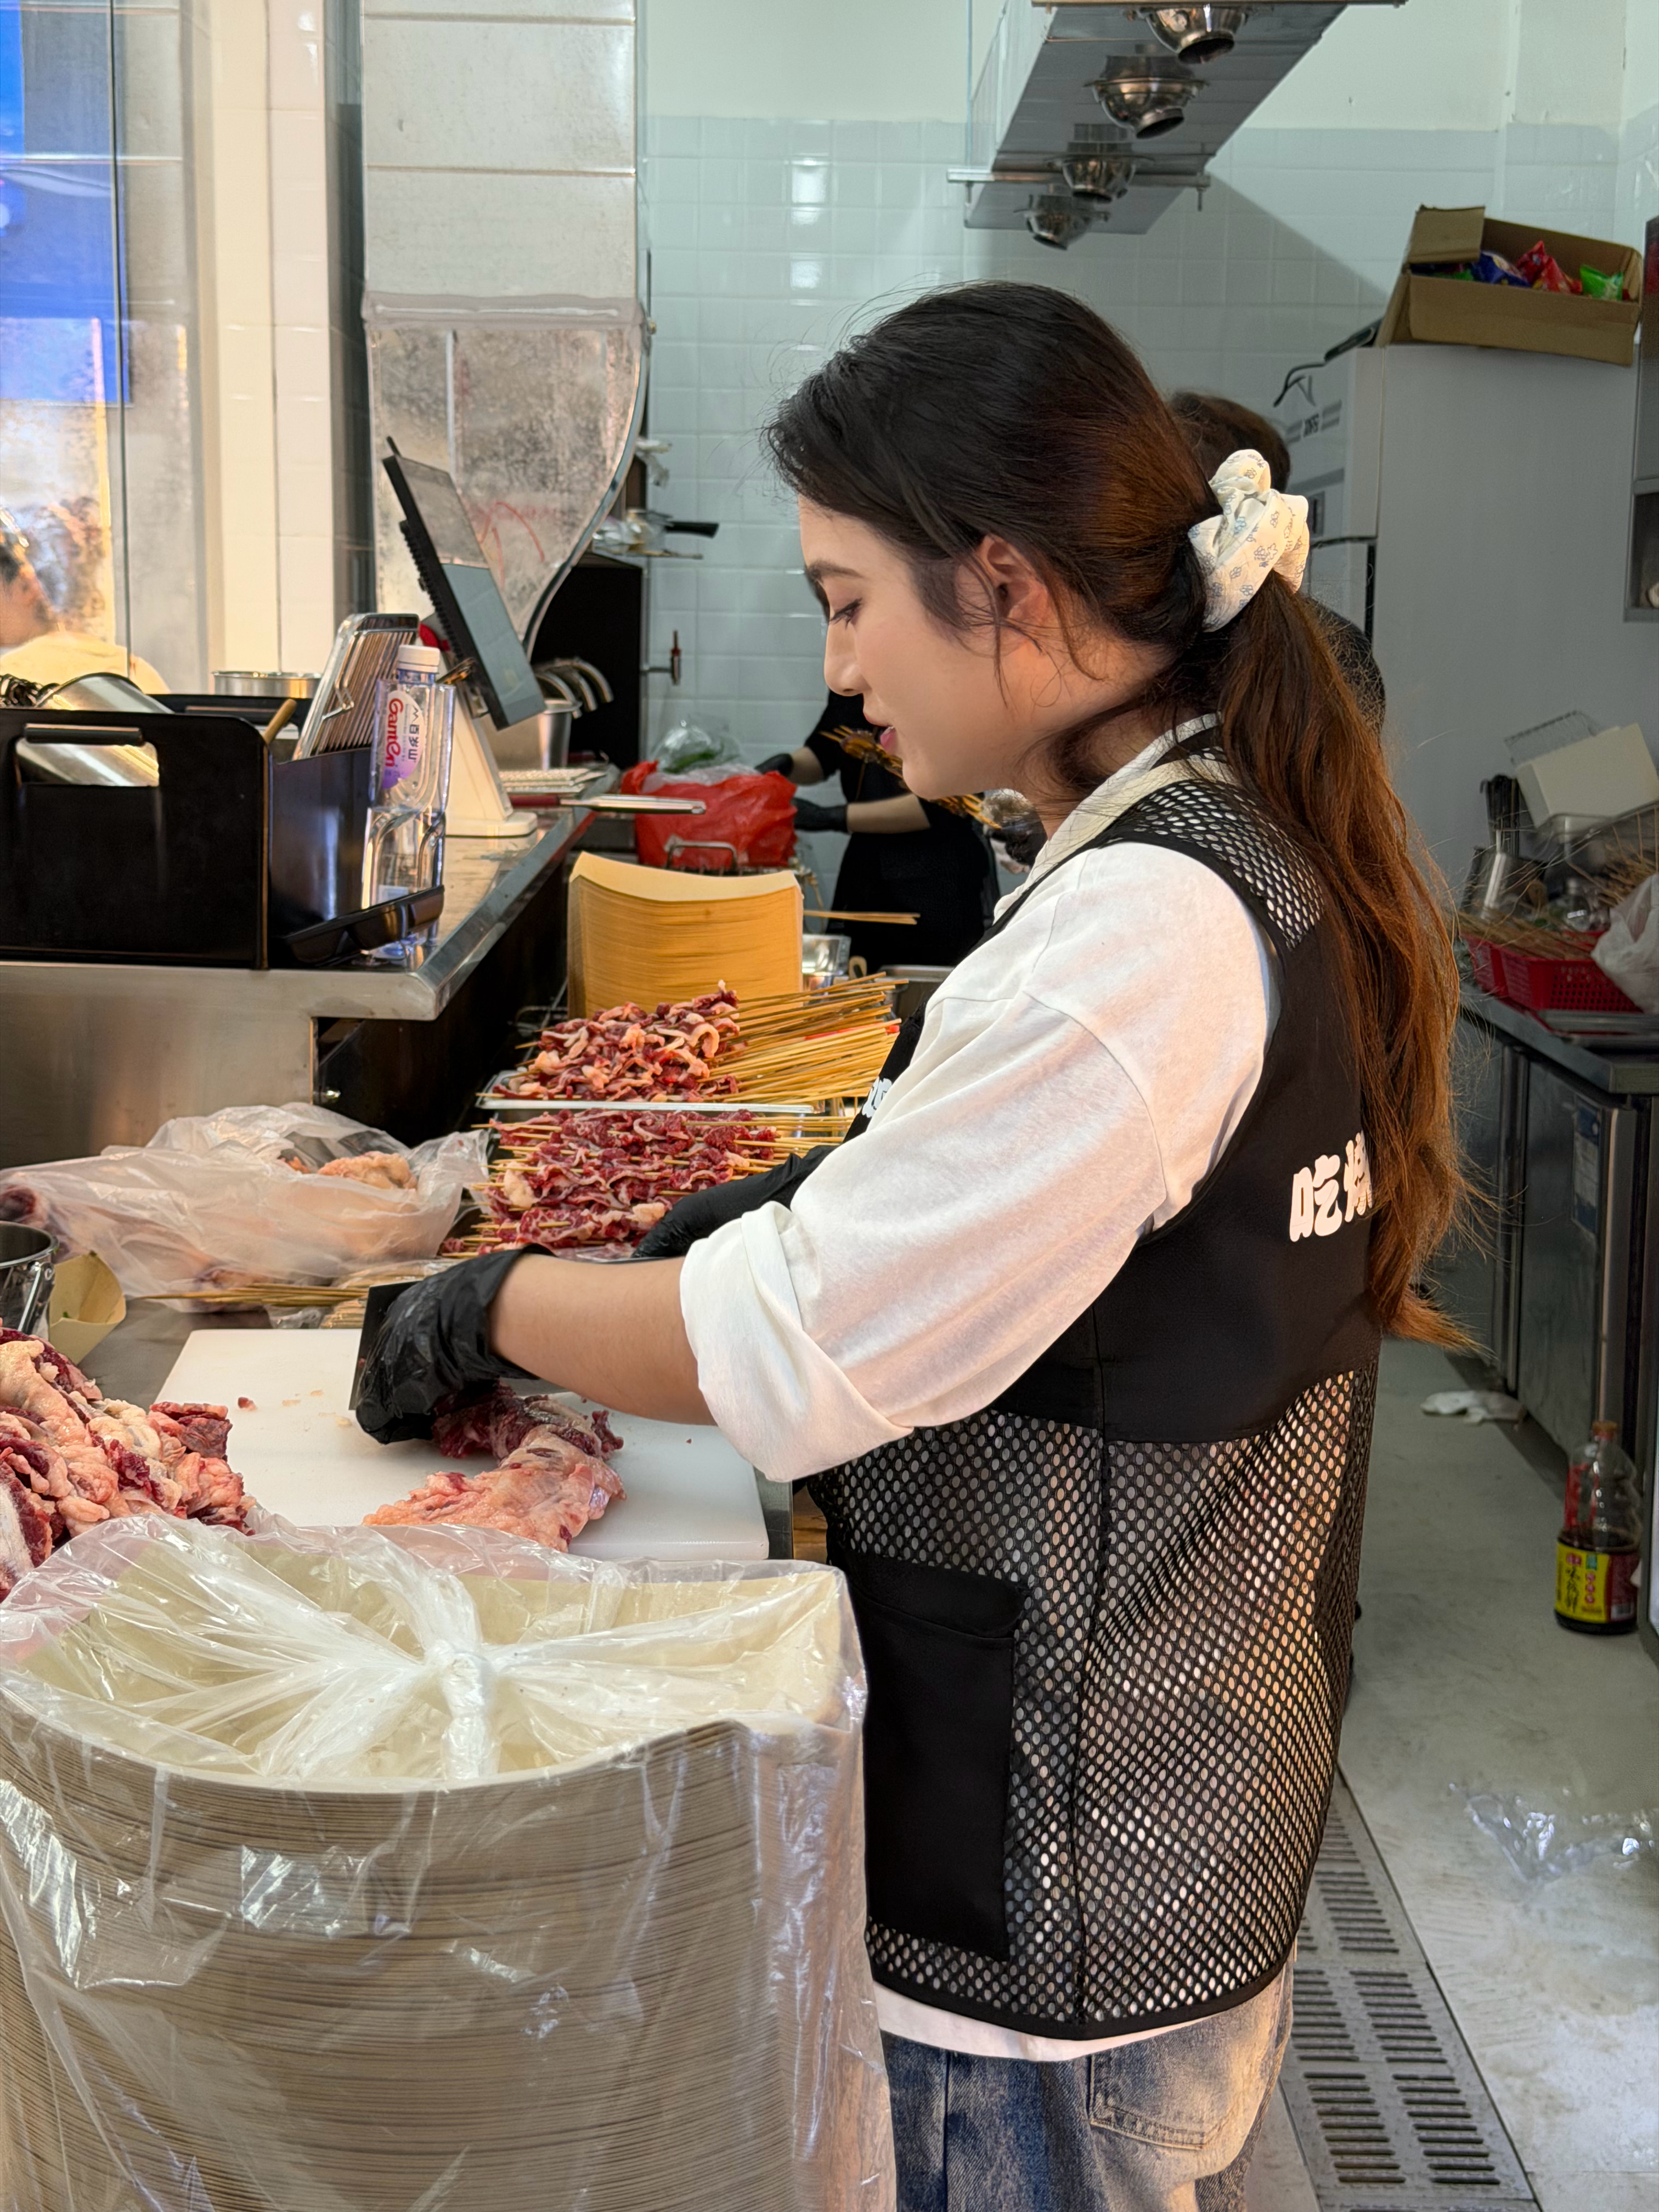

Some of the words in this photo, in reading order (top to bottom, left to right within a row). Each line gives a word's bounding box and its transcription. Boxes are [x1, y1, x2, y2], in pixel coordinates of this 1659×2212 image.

[386, 698, 403, 767] Ganten
[408, 724, 420, 761] 百岁山
